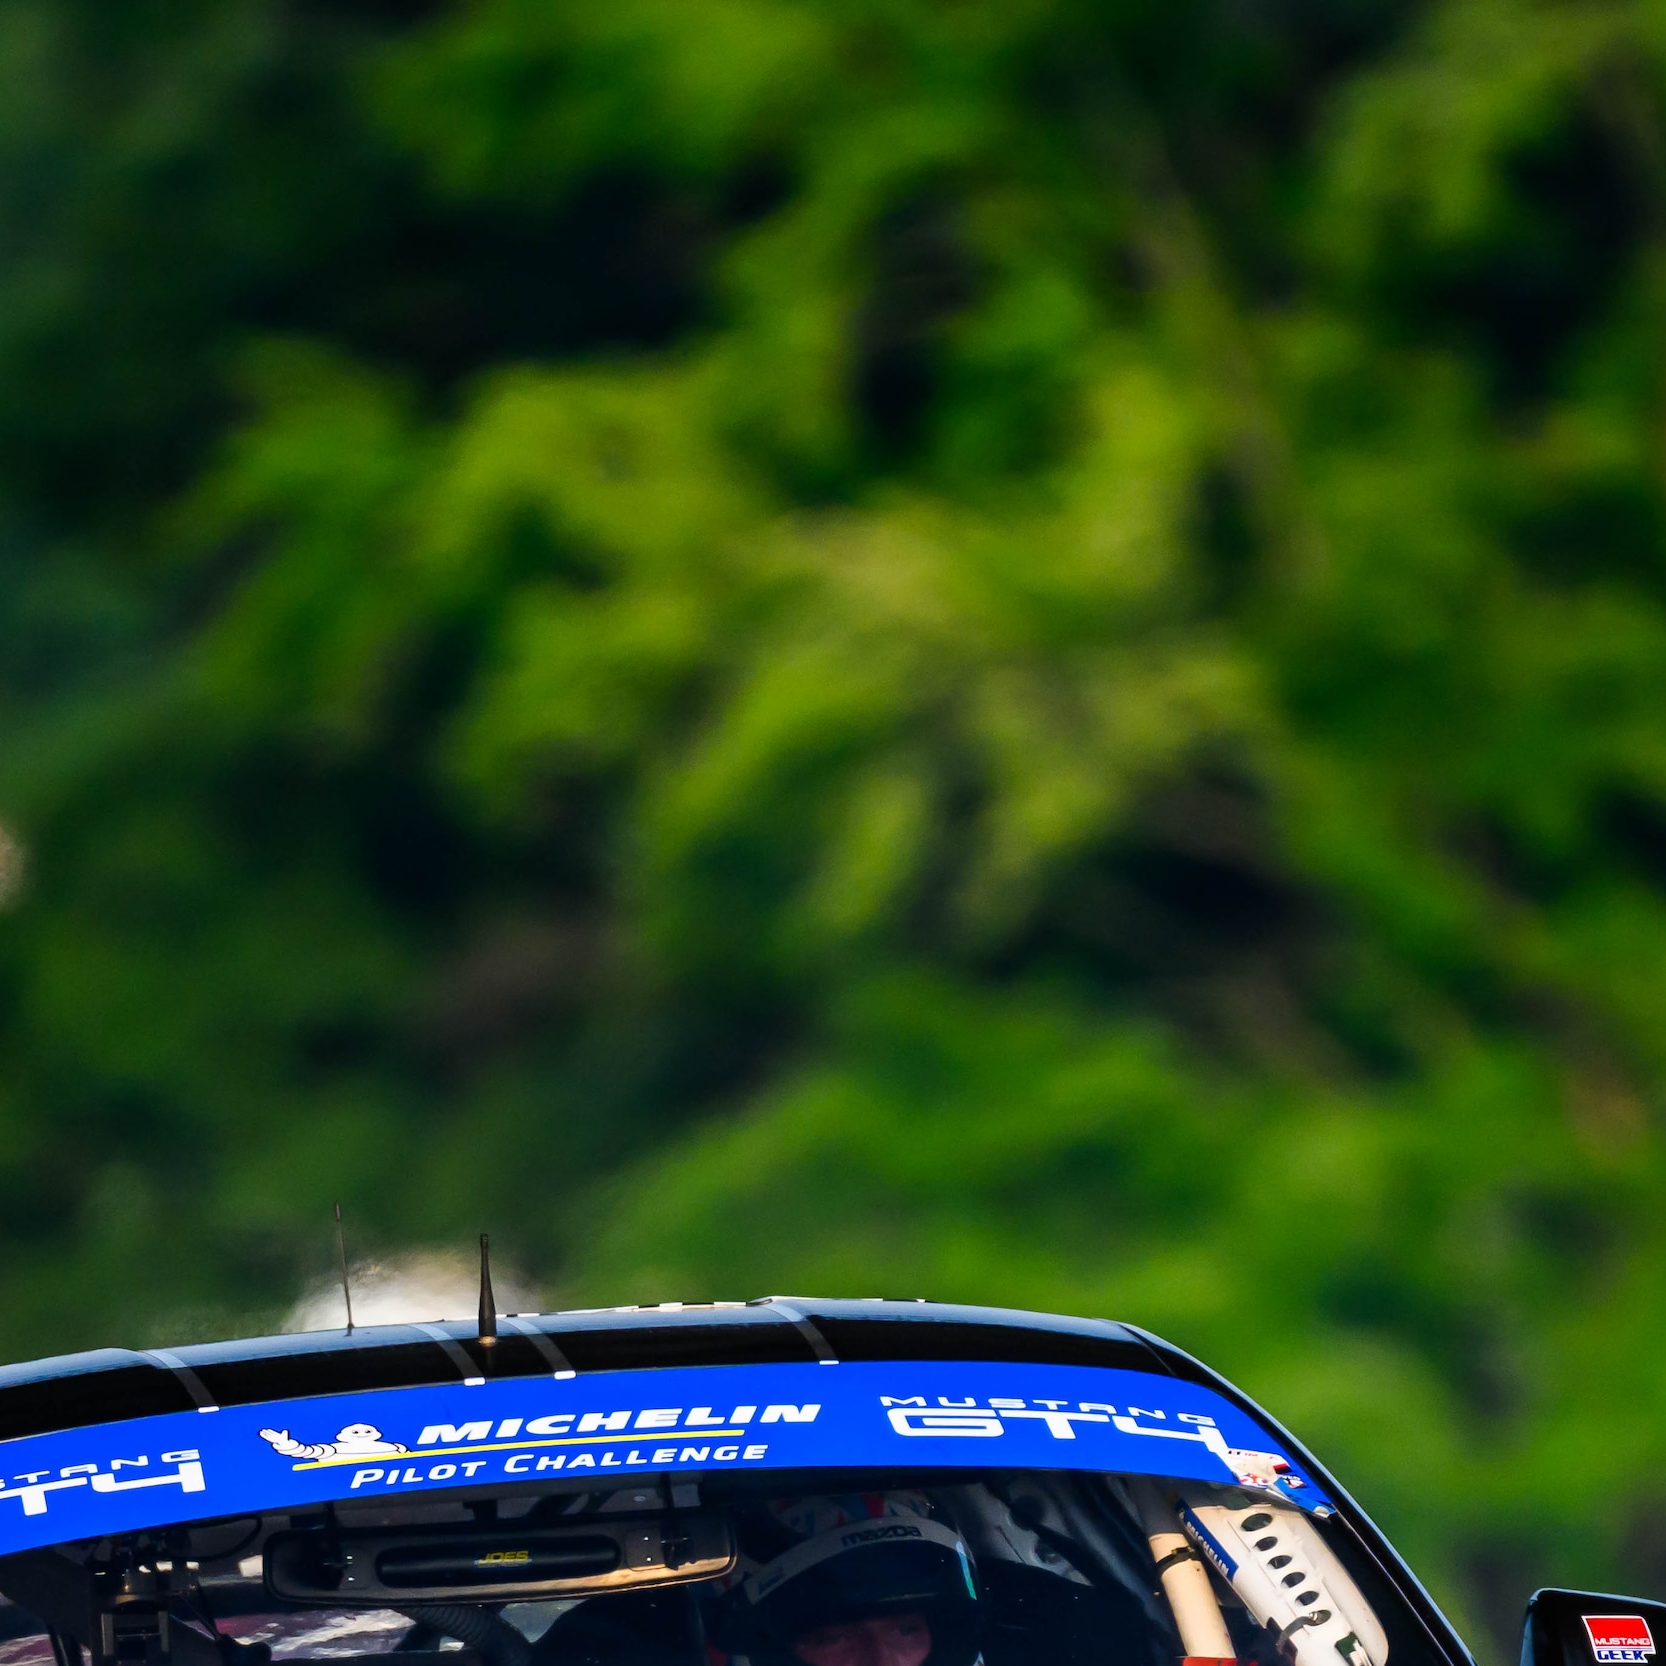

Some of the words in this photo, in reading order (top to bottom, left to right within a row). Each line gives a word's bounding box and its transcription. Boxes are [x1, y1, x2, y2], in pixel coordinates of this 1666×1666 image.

[416, 1404, 822, 1445] MICHELIN
[879, 1396, 1217, 1427] MUSTANG
[886, 1407, 1231, 1456] GT4
[350, 1460, 487, 1489] PILOT
[503, 1444, 769, 1474] CHALLENGE
[1594, 1637, 1651, 1646] MUSTANG
[1596, 1650, 1645, 1661] GEEK
